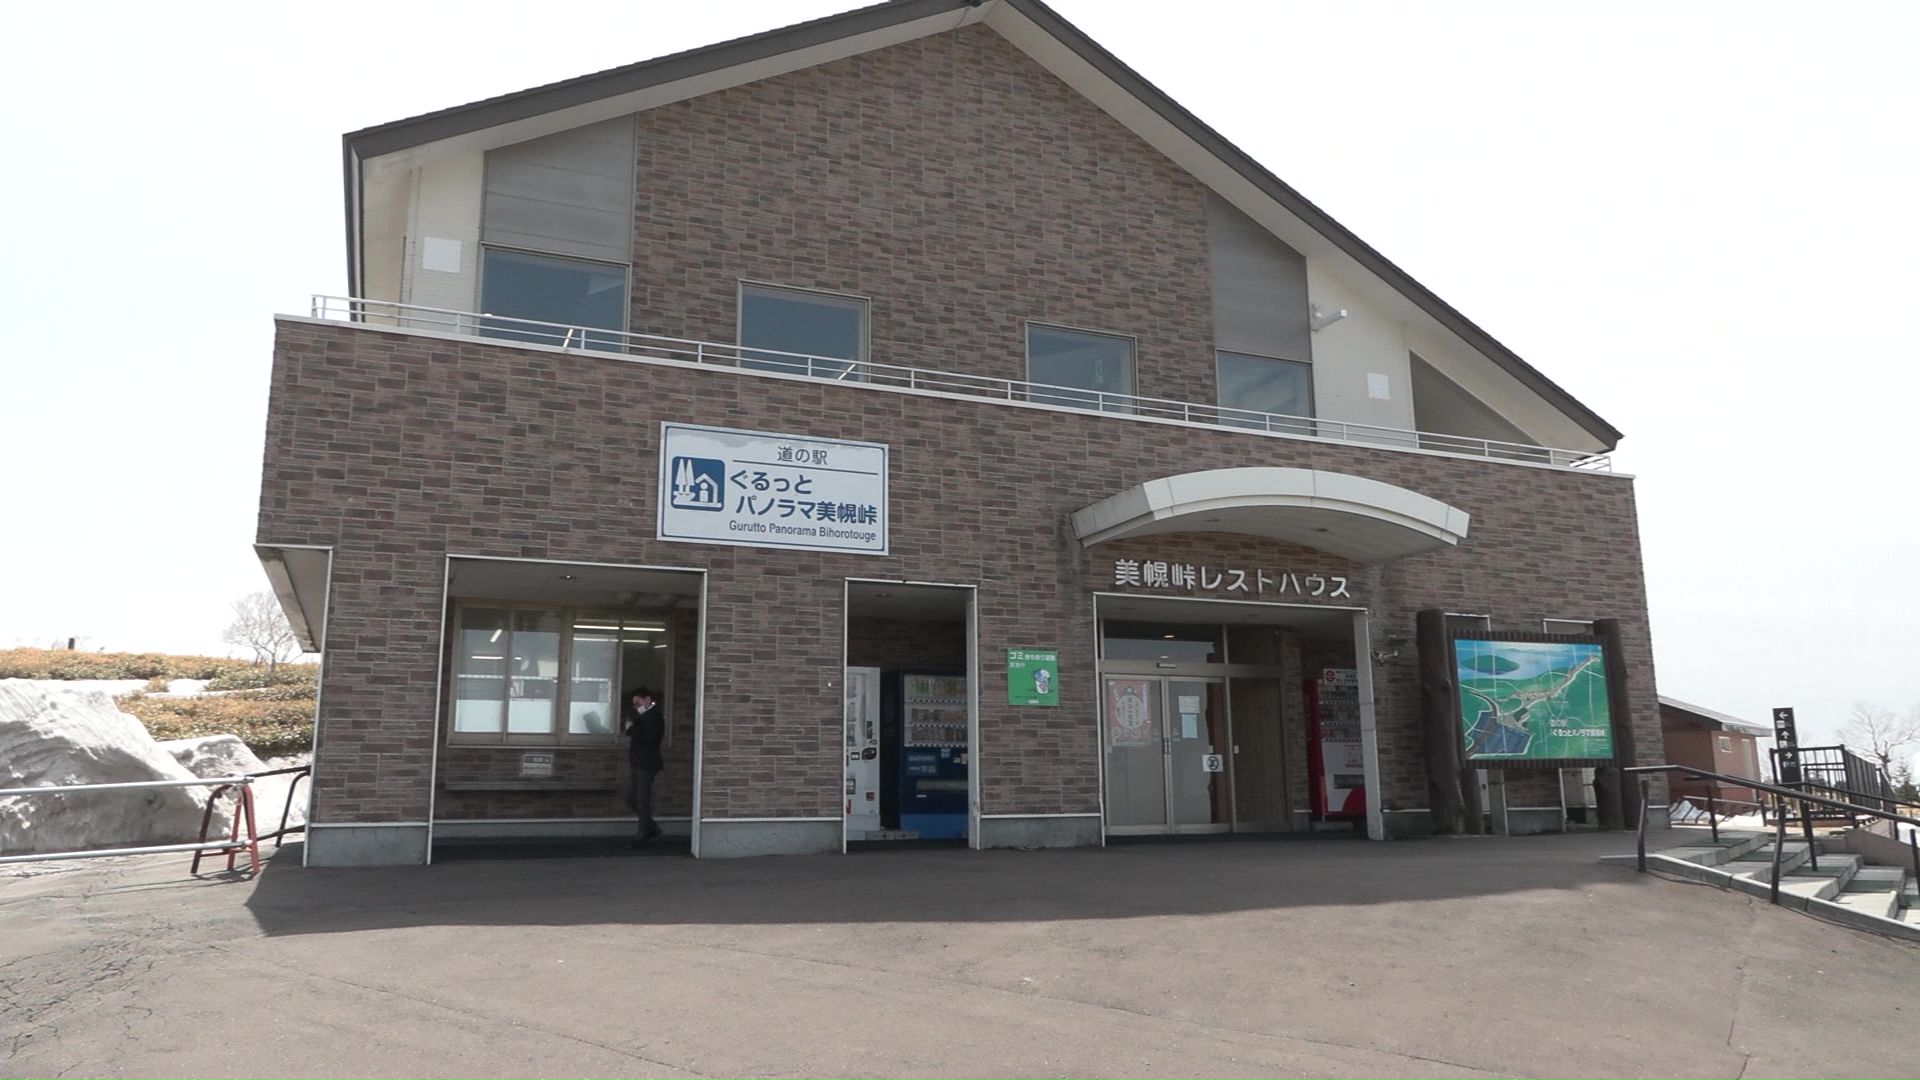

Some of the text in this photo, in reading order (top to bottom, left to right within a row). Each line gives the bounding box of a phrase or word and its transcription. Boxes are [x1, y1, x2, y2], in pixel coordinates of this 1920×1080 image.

[777, 447, 827, 465] 道の駅
[730, 470, 812, 494] ぐるっと
[736, 495, 877, 525] パノラマ美幌峠
[729, 520, 876, 542] Gurutto Panorama Bihorotouge
[1114, 558, 1351, 598] 美幌峠レストハウス
